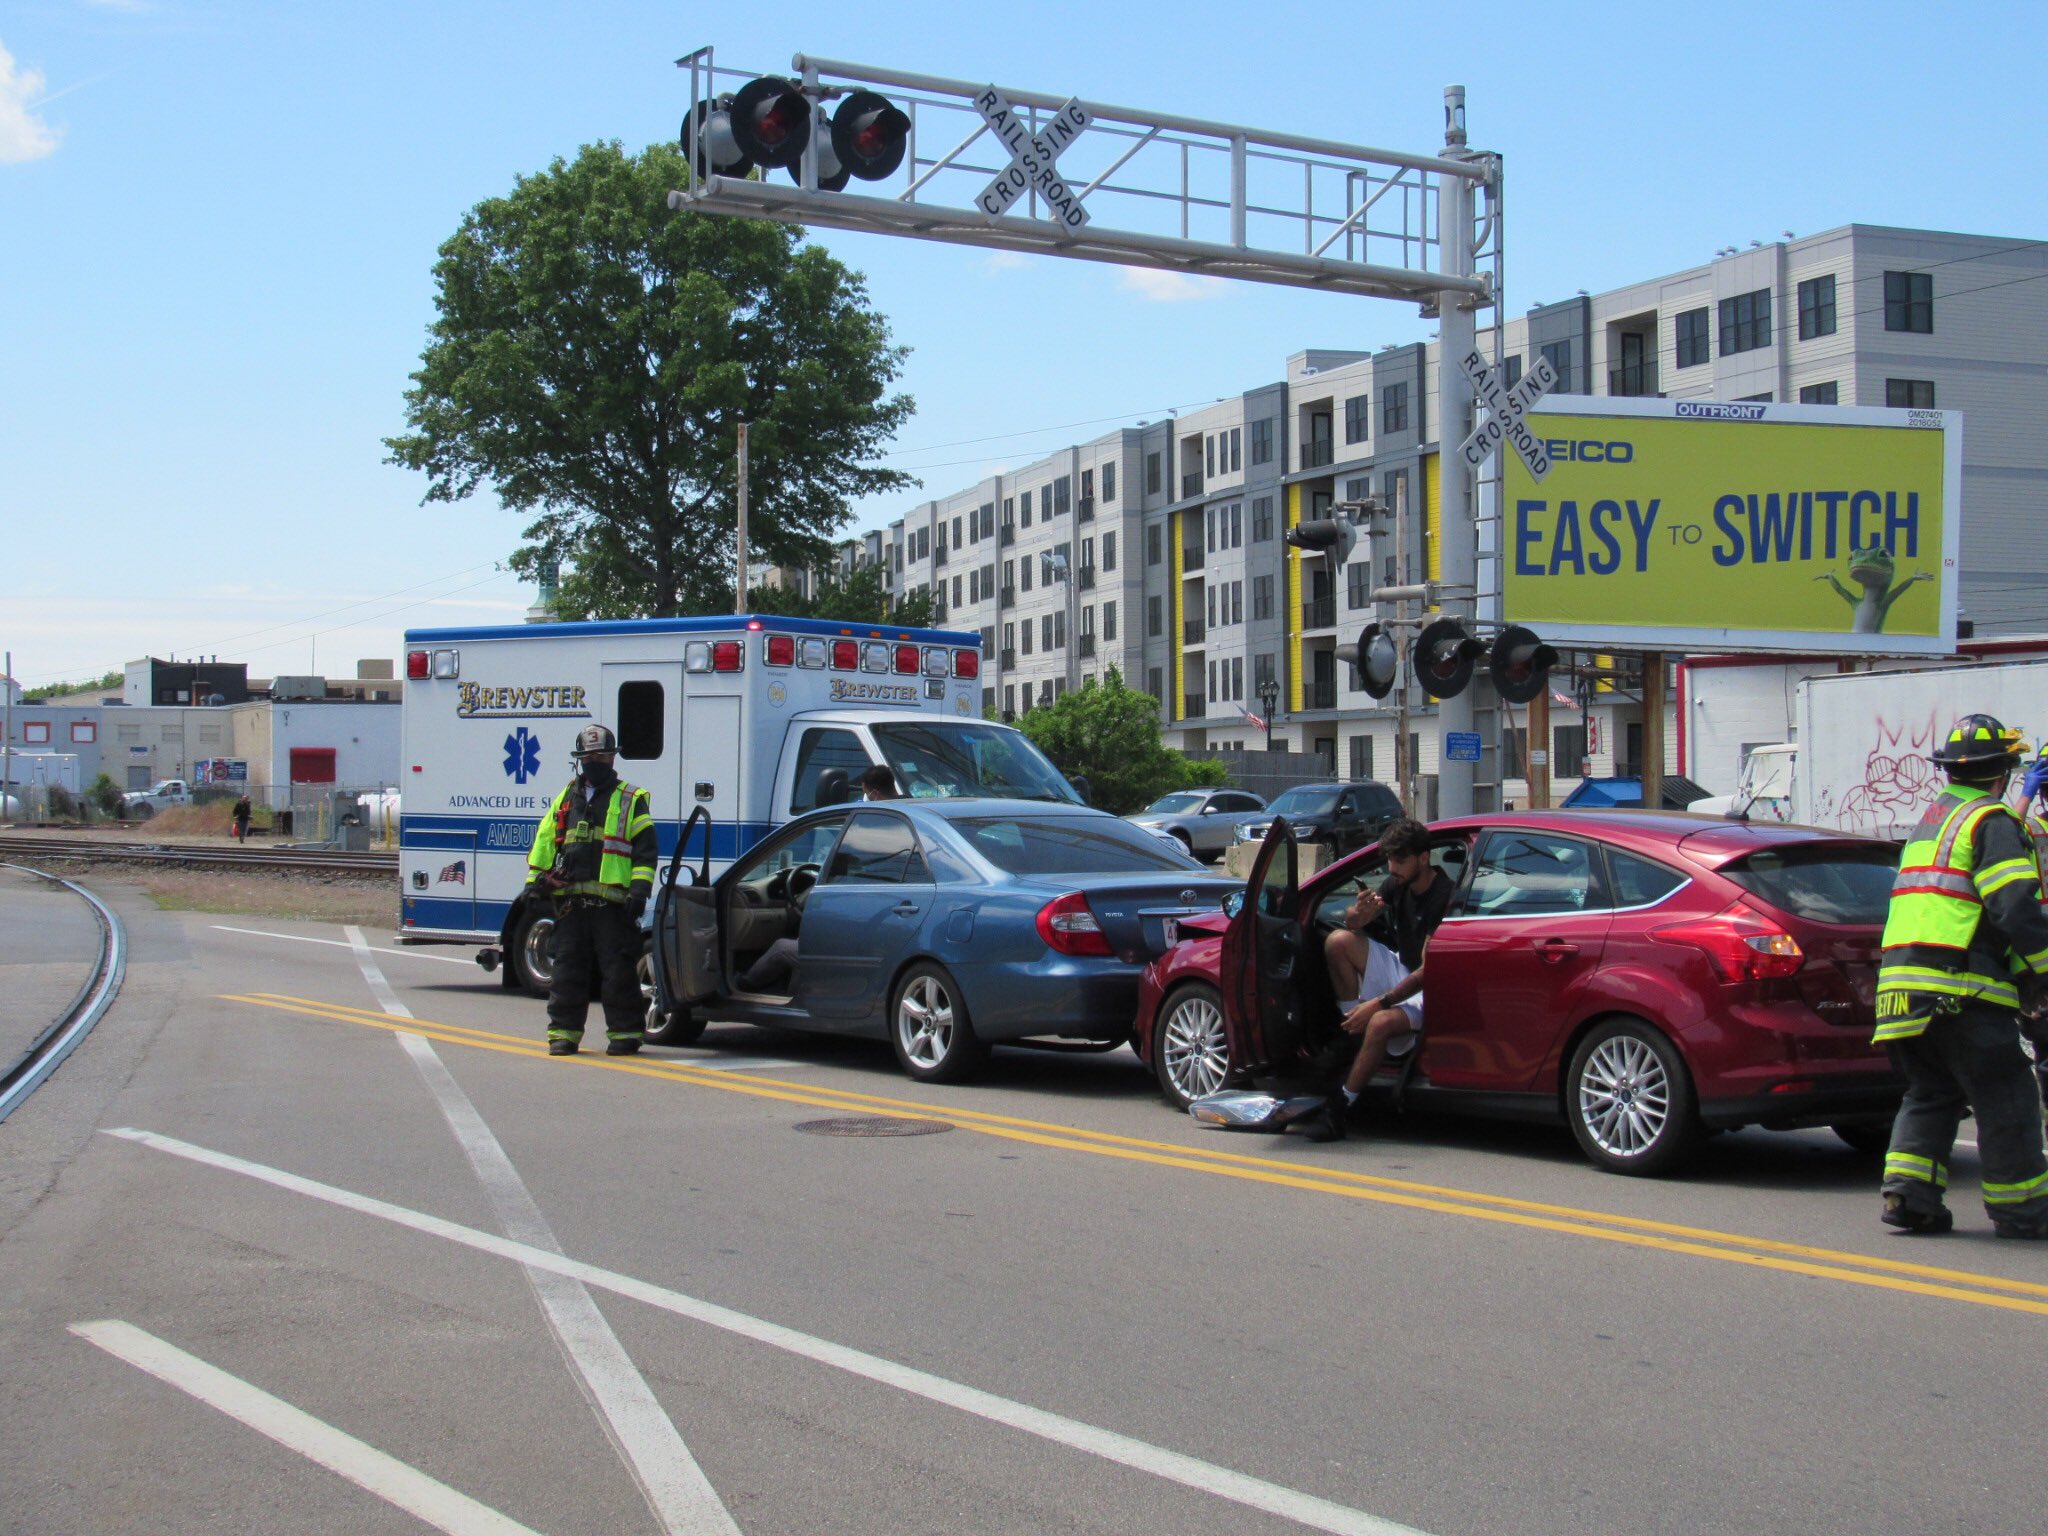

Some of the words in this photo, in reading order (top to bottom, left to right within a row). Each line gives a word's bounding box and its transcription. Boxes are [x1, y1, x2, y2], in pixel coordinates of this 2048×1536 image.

[980, 90, 1023, 152] RAIL
[1037, 168, 1082, 226] ROAD
[983, 106, 1085, 215] CROSSING
[1464, 352, 1499, 408] RAIL
[1506, 422, 1547, 475] ROAD
[1466, 365, 1551, 464] CROSSING
[1678, 403, 1762, 418] OUTFRONT
[1537, 438, 1633, 463] EICO
[1515, 498, 1661, 576] EASY
[1667, 524, 1703, 546] TO
[1712, 489, 1919, 567] SWITCH
[457, 681, 587, 715] BREWSTER
[830, 677, 919, 702] BREWSTER
[588, 731, 598, 743] 3
[449, 796, 511, 809] ADVANCED
[515, 796, 535, 809] LIFE
